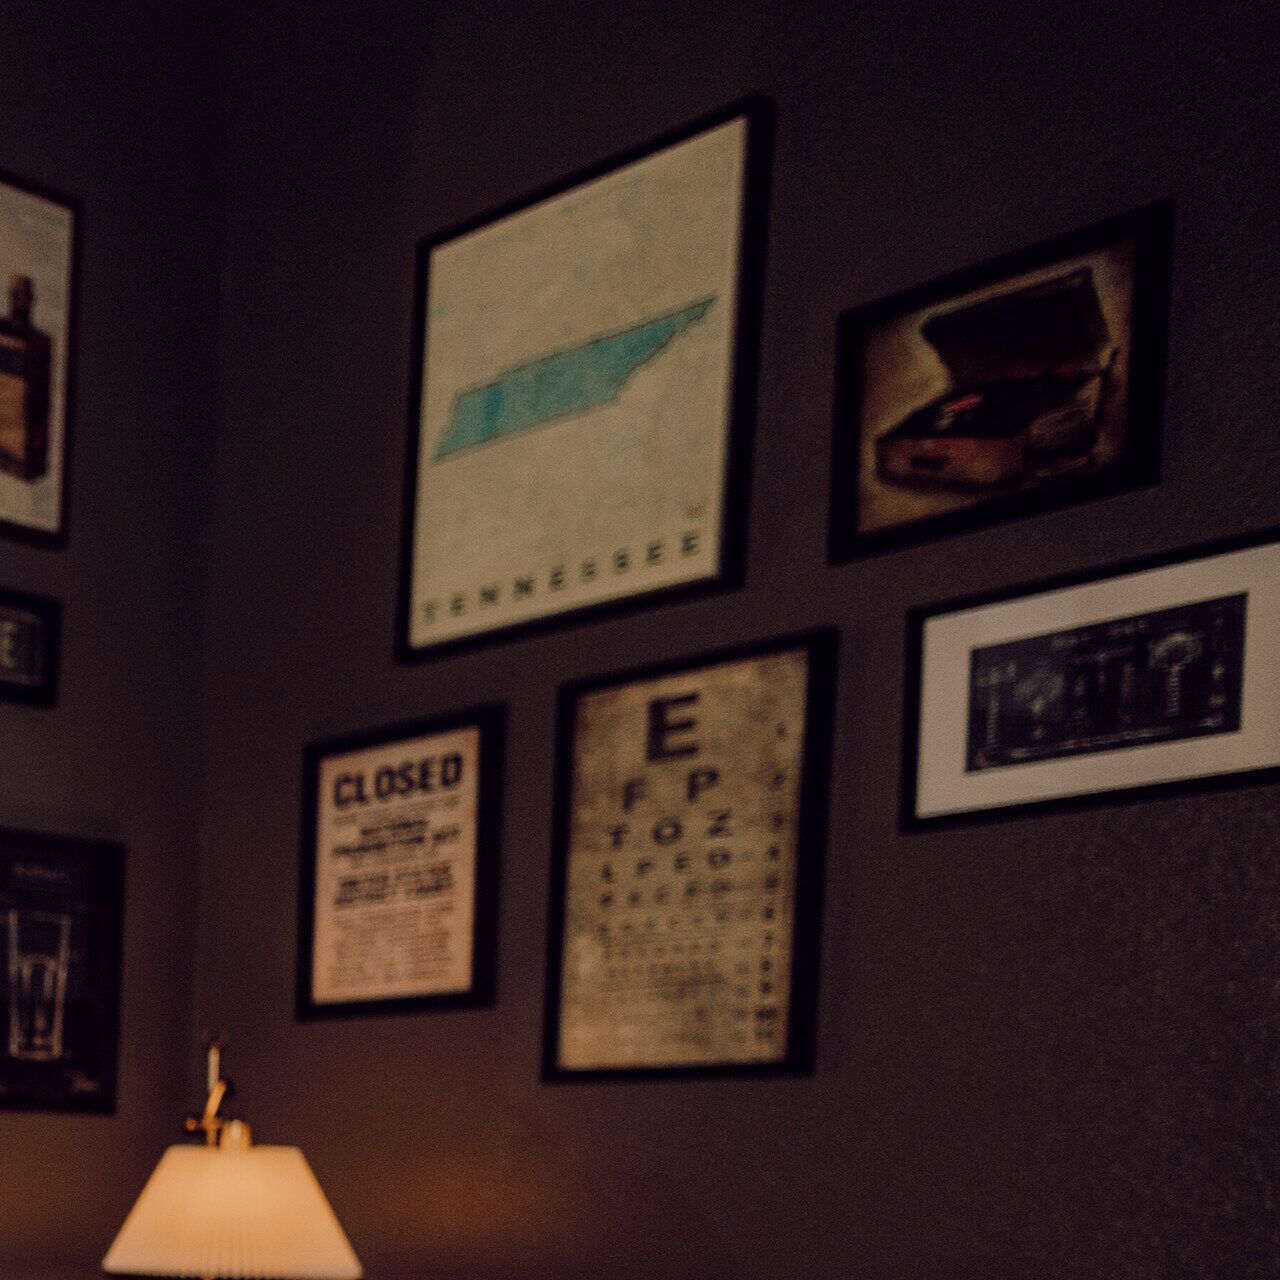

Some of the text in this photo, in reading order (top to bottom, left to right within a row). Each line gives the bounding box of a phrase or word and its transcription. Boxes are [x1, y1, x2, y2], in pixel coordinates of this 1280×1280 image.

[422, 531, 700, 625] TENNESSEE
[646, 692, 700, 764] E
[334, 751, 464, 808] CLOSED
[687, 766, 720, 804] P
[650, 816, 684, 846] O
